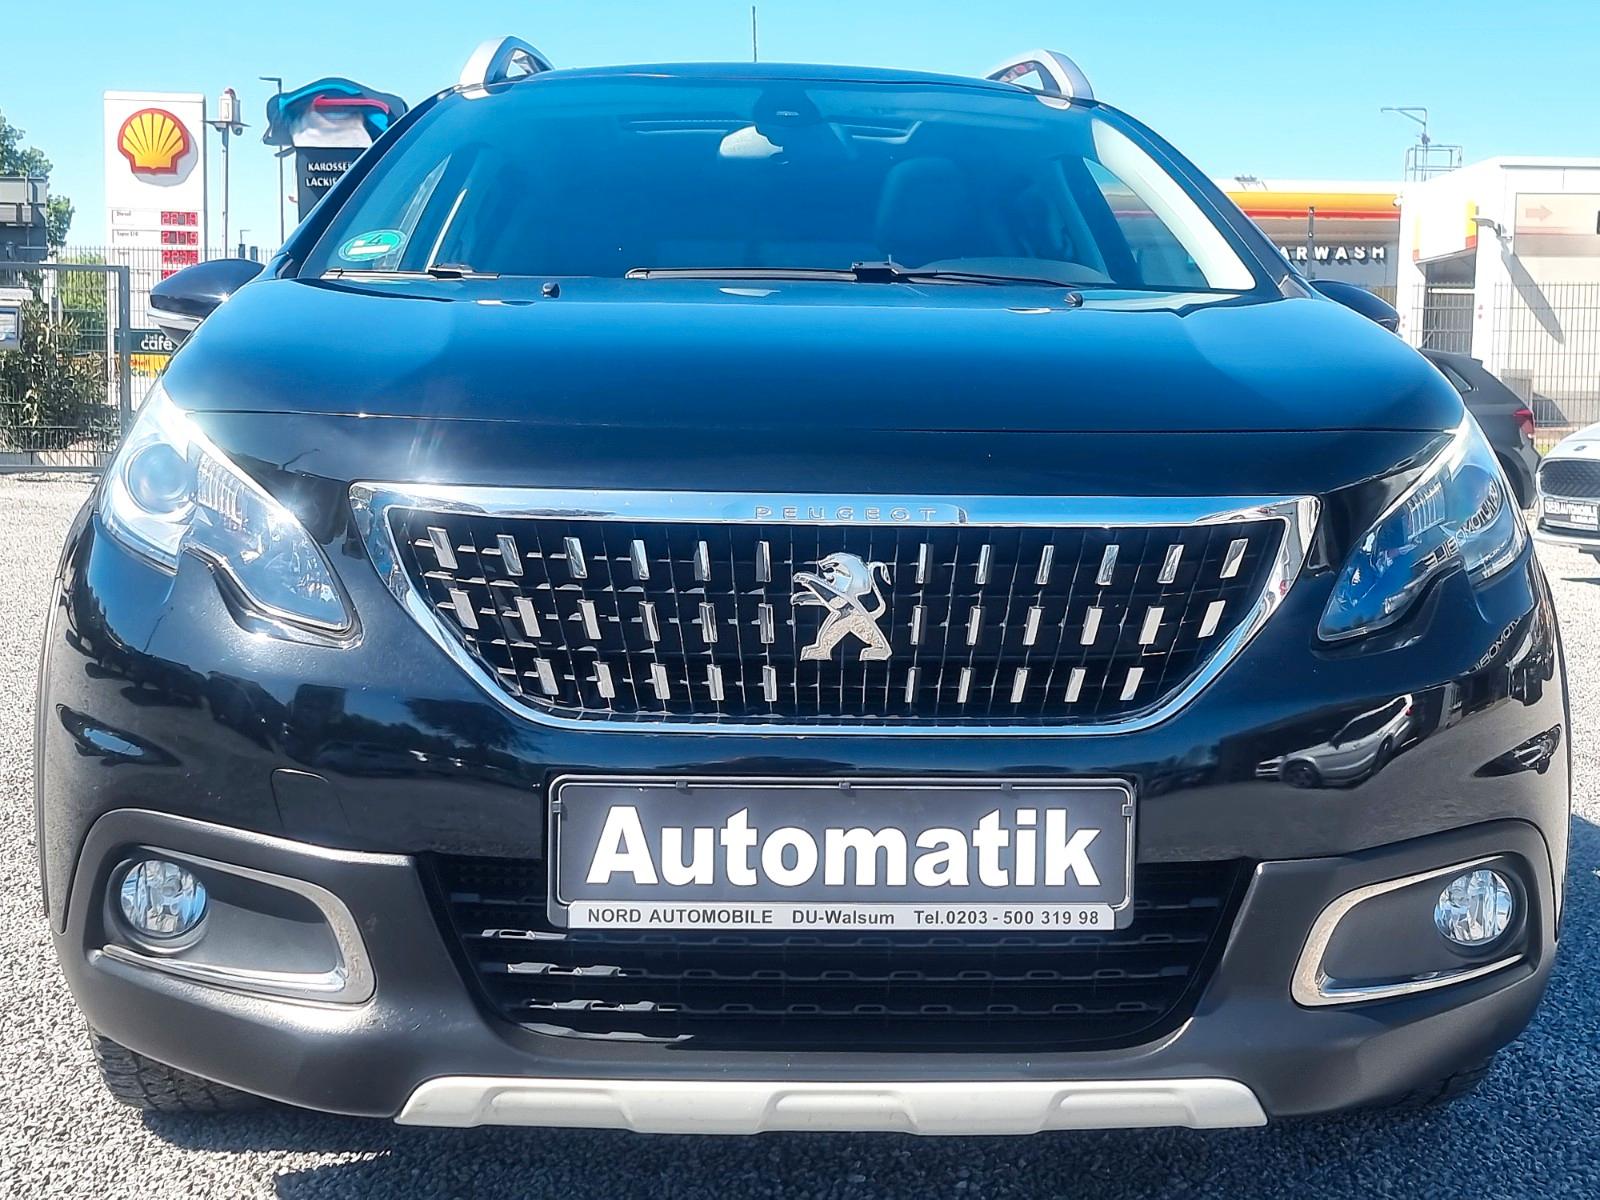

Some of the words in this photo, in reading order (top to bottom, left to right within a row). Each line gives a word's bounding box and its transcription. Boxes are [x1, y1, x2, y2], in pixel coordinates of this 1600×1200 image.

[1280, 246, 1385, 260] ARWASH
[755, 506, 936, 521] PEUGEOT
[585, 804, 1102, 888] Automatik
[588, 908, 642, 923] NORD
[649, 909, 773, 924] AUTOMOBILE
[792, 910, 895, 924] DU-Walsum
[914, 910, 988, 925] Tel.0203
[1003, 911, 1035, 925] 500
[1041, 911, 1072, 925] 319
[1079, 911, 1099, 925] 98
